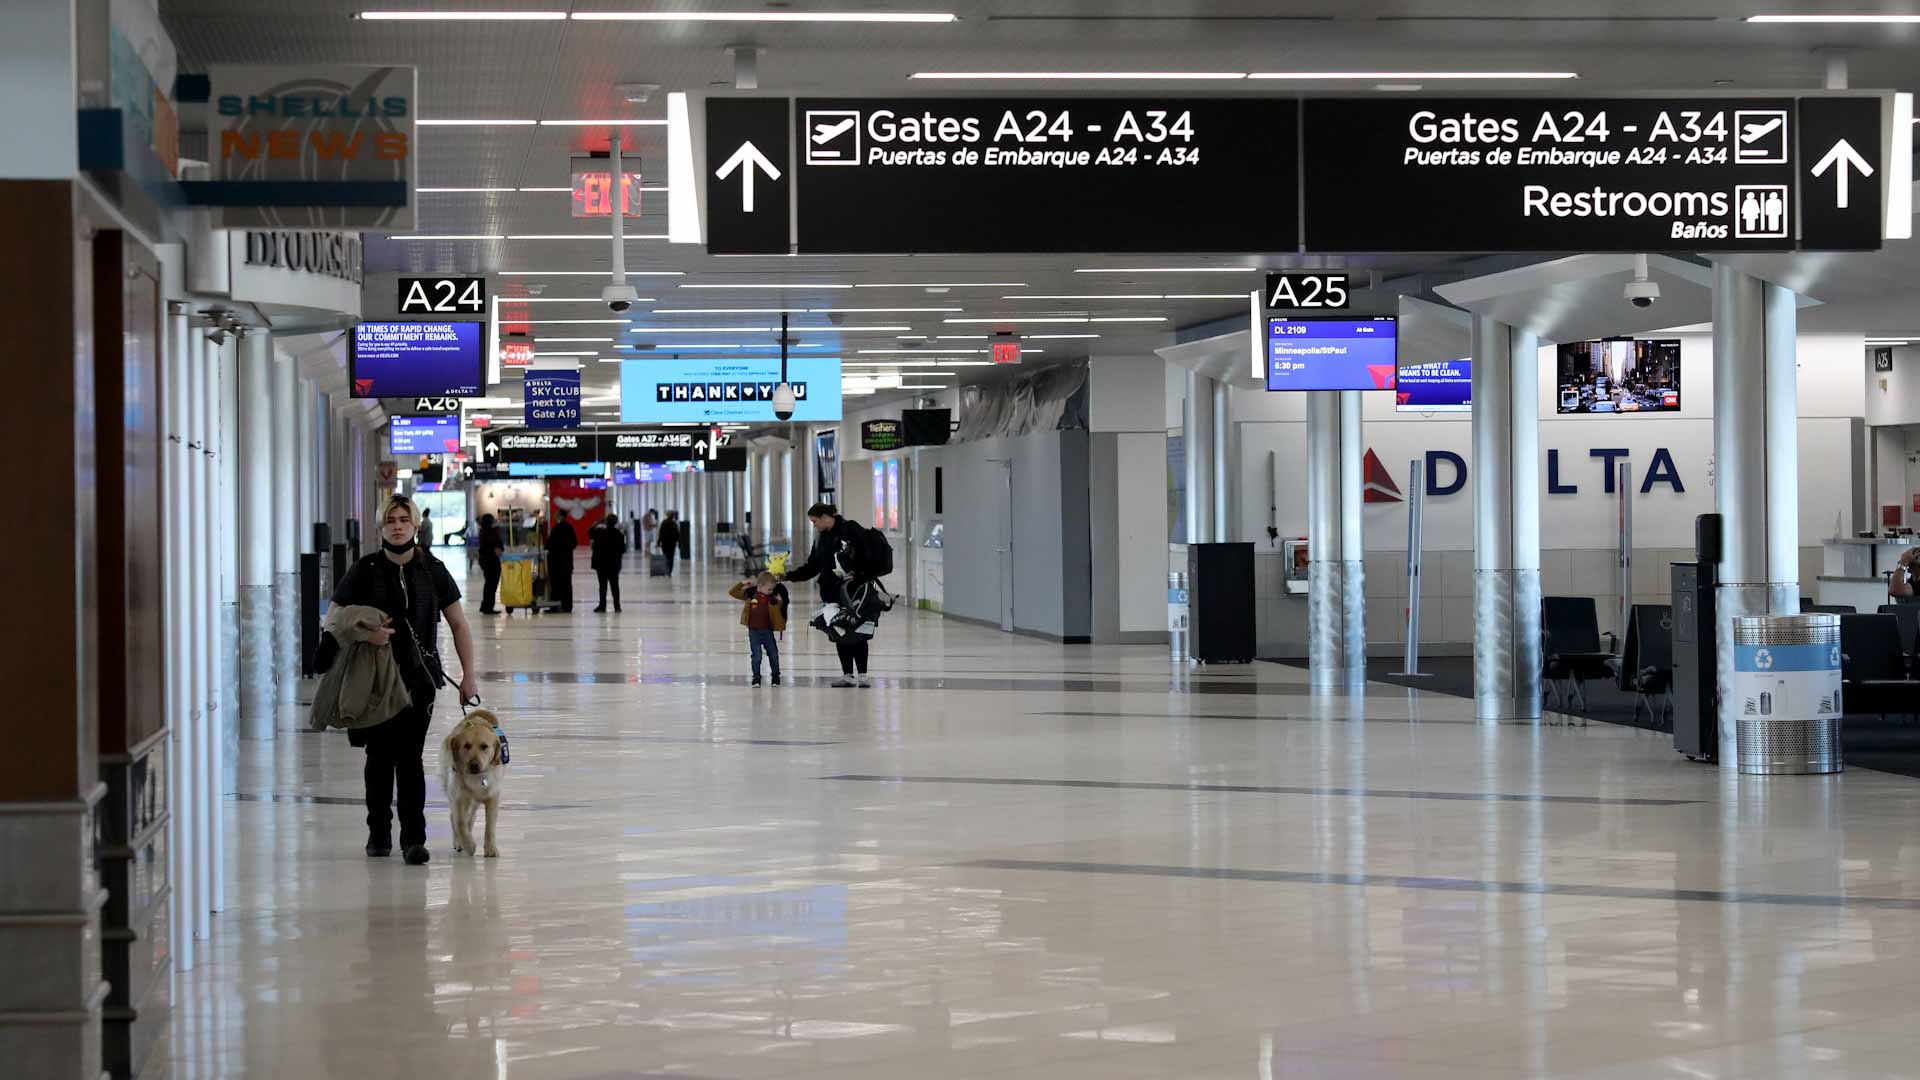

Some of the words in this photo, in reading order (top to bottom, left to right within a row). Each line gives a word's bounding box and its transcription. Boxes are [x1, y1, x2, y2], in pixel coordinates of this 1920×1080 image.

[218, 95, 407, 118] SHELLIS
[868, 110, 980, 143] Gates
[994, 110, 1073, 143] A24
[1088, 124, 1101, 132] -
[1114, 110, 1195, 143] A34
[1408, 111, 1519, 143] Gates
[1532, 111, 1610, 143] A24
[1649, 111, 1729, 143] A34
[221, 131, 409, 160] NEWS
[868, 147, 946, 166] Puertas
[952, 147, 979, 166] de
[984, 147, 1090, 169] Embarque
[1095, 147, 1137, 166] A24
[1157, 147, 1200, 166] A34
[1403, 147, 1481, 166] Puertas
[1486, 147, 1513, 166] de
[1517, 147, 1620, 168] Embarque
[1625, 147, 1667, 165] A24
[1686, 147, 1728, 165] A34
[585, 178, 631, 213] EXT
[1524, 185, 1729, 217] Restrooms
[1671, 220, 1729, 239] Baños
[401, 280, 483, 311] A24
[1269, 276, 1347, 307] A25
[357, 325, 366, 333] IN
[367, 325, 389, 333] TIMES
[390, 325, 399, 333] OF
[401, 325, 422, 333] RAPID
[357, 333, 373, 341] OUR
[374, 333, 423, 341] COMMITMENT
[425, 333, 459, 341] REMAINS.
[1274, 326, 1285, 334] DL
[1287, 326, 1307, 334] 2109
[1274, 347, 1347, 355] Minneapolis/StPaul
[1876, 352, 1889, 368] A25
[532, 387, 551, 396] SKY
[553, 387, 579, 396] CLUB
[659, 385, 737, 399] THANK
[760, 385, 805, 398] YU
[416, 398, 459, 411] A26
[532, 399, 553, 407] next
[556, 399, 566, 407] to
[532, 409, 558, 418] Gate
[558, 409, 577, 418] A19
[513, 435, 537, 443] Gates
[537, 435, 554, 443] A27
[559, 435, 577, 443] A34
[617, 435, 640, 443] Gates
[663, 435, 679, 443] A34
[1425, 448, 1685, 497] DLTA
